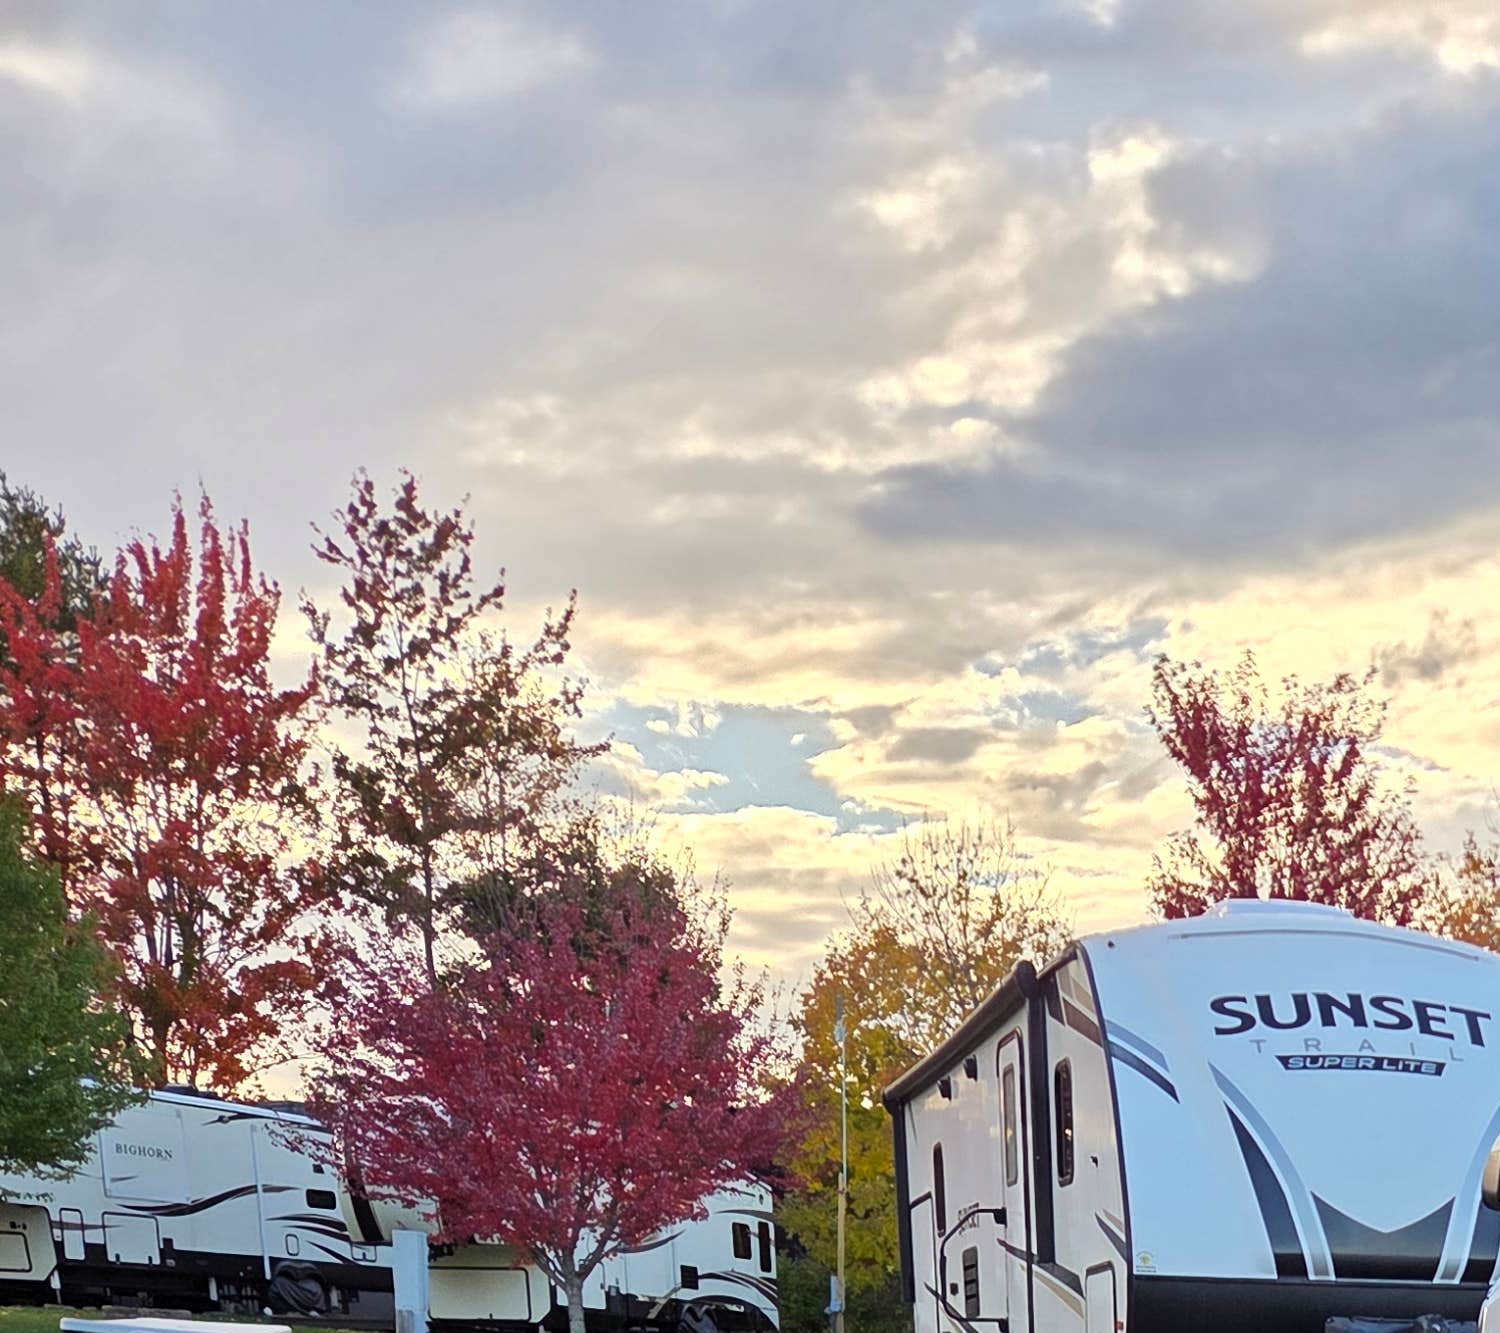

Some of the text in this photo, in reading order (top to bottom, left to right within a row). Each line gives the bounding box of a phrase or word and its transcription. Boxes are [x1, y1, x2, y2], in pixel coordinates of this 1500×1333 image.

[1209, 992, 1492, 1048] SUNSET
[1250, 1038, 1465, 1062] TRAIL
[1287, 1056, 1437, 1075] SUPER LITE
[115, 1143, 173, 1159] BIGHORN
